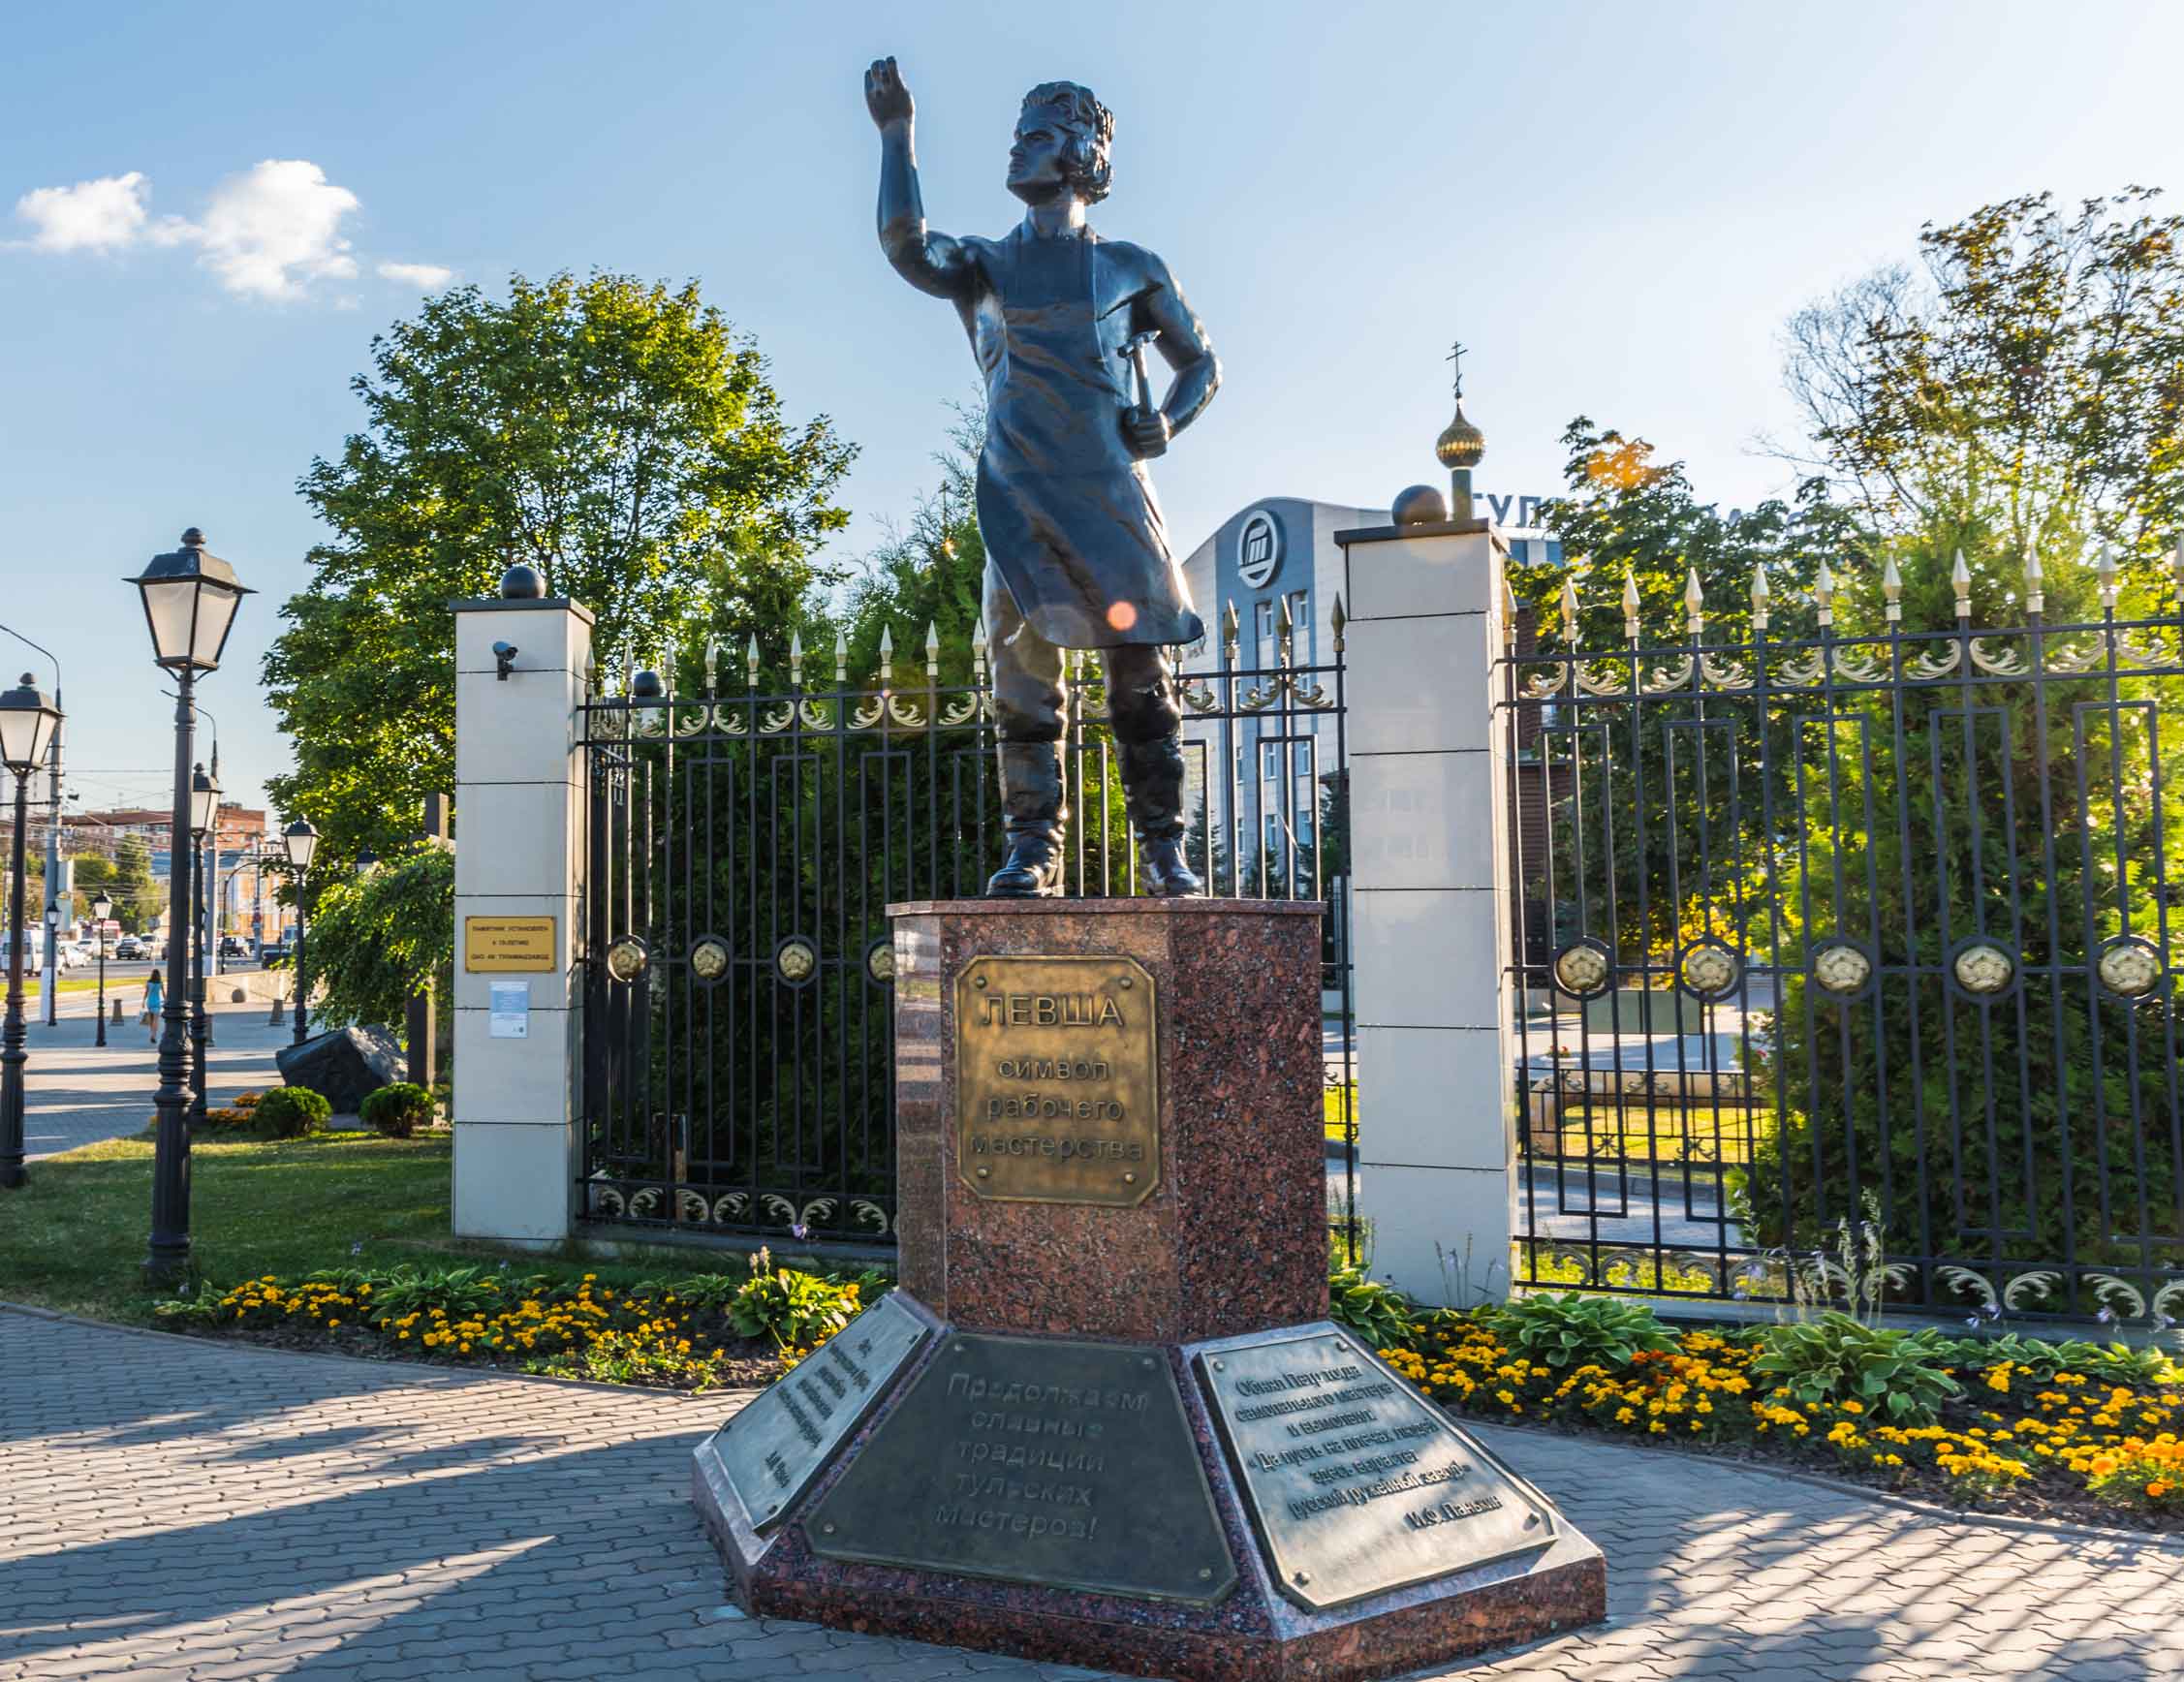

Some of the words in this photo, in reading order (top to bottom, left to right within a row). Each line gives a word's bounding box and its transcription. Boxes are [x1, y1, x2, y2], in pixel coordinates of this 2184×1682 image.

[982, 994, 1125, 1027] ЛЕВША
[998, 1059, 1110, 1081] символ
[986, 1092, 1126, 1123] рабочего
[971, 1135, 1145, 1162] мастерства
[946, 1371, 1149, 1412] Продолжаем
[971, 1410, 1104, 1440] славные
[955, 1441, 1105, 1473] традиции
[956, 1472, 1094, 1507] тульских
